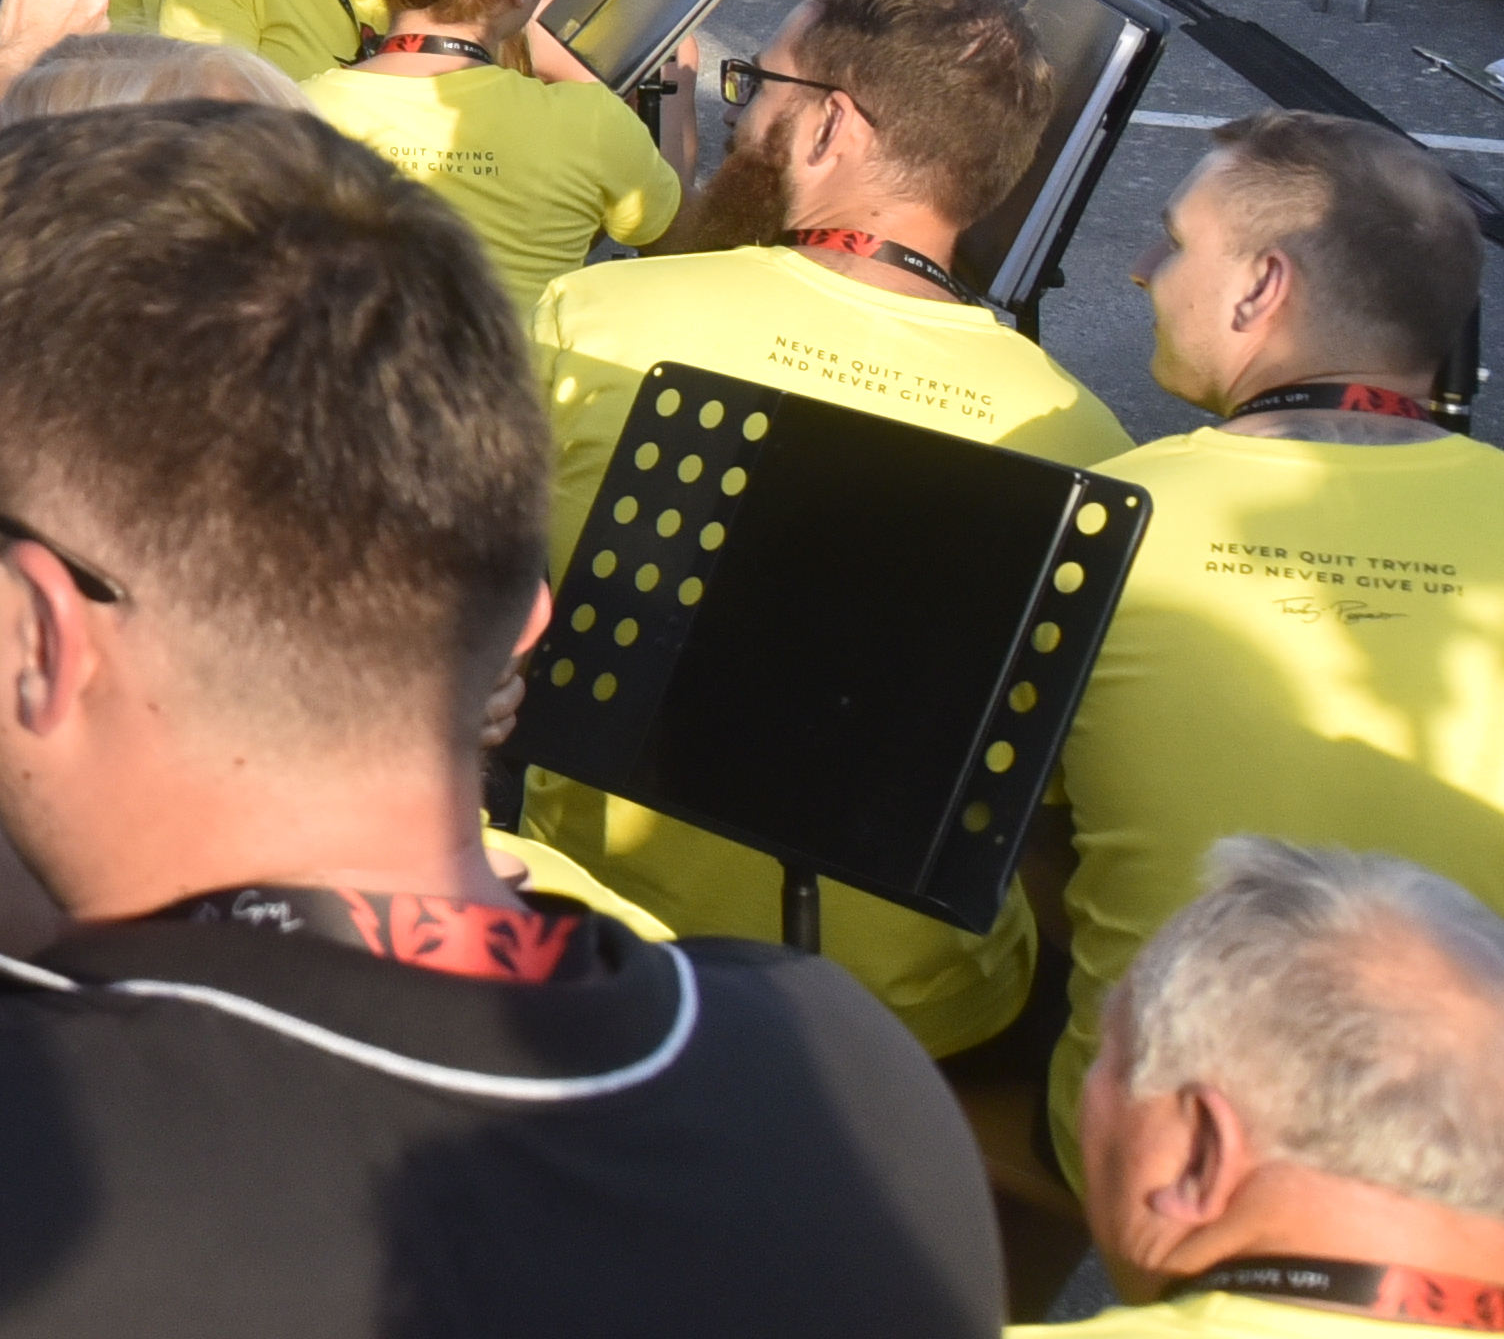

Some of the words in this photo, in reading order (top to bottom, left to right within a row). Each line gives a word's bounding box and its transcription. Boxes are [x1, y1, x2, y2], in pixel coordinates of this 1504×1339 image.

[389, 145, 428, 159] QUIT
[436, 150, 496, 163] TRYING
[427, 162, 466, 174] GIVE
[472, 166, 501, 178] UP!
[767, 351, 810, 373] AND
[821, 367, 888, 395] NEVER
[899, 388, 949, 410] GIVE
[961, 404, 995, 425] UP!
[775, 335, 840, 365] NEVER
[850, 359, 904, 382] QUIT
[914, 375, 994, 407] TRYING
[1209, 541, 1289, 561] NEVER
[1298, 550, 1357, 569] QUIT
[1366, 556, 1458, 578] TRYING
[1204, 560, 1255, 577] AND
[1263, 566, 1347, 587] NEVER
[1354, 575, 1415, 594] GIVE
[1422, 581, 1465, 599] UP!
